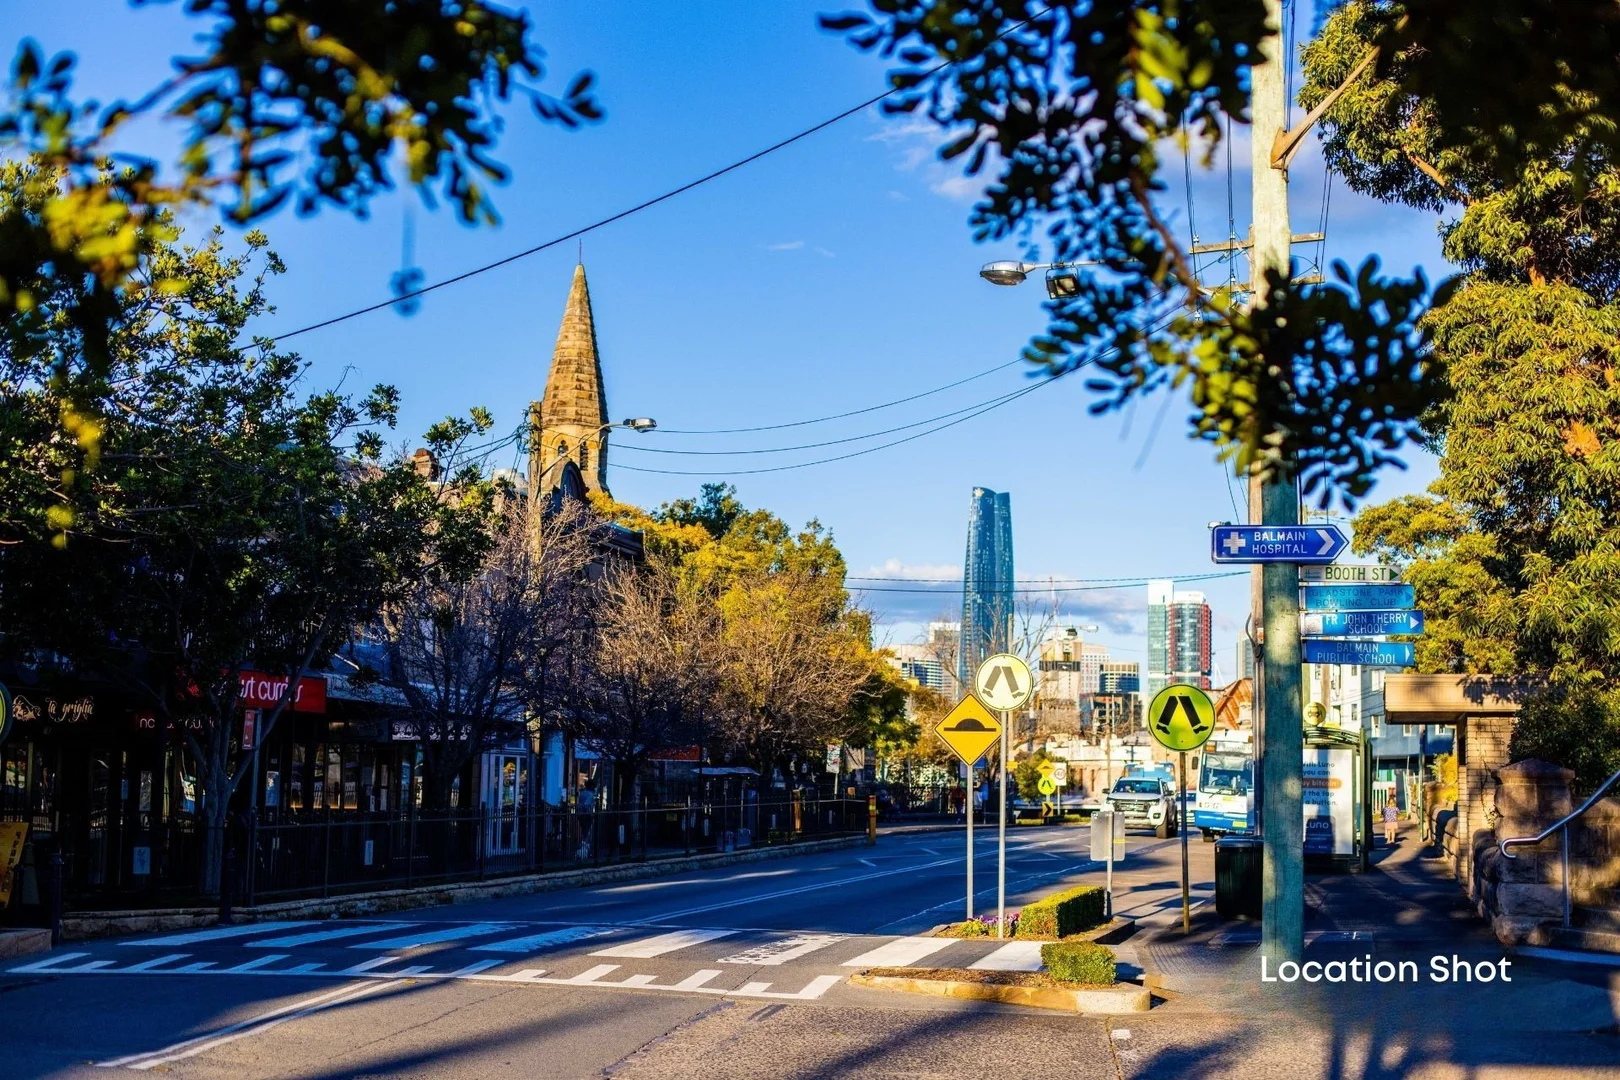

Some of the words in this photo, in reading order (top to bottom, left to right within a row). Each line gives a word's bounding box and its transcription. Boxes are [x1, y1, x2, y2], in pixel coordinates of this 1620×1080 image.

[1254, 531, 1306, 541] BALMAIN
[1252, 544, 1307, 554] HOSPITAL
[1325, 567, 1366, 580] BOOTH
[1372, 567, 1386, 580] ST
[1312, 588, 1372, 597] GLADSTONE
[1379, 587, 1404, 596] PARK
[1315, 598, 1362, 607] BOWLING
[1370, 598, 1396, 606] CLUB
[1325, 614, 1338, 625] FR
[1343, 613, 1367, 625] JOHN
[1372, 612, 1408, 624] THERRY
[1348, 624, 1386, 634] SCHOOL
[1336, 642, 1379, 653] BALMAIN
[1317, 652, 1352, 663] PUBLIC
[1357, 653, 1397, 664] SCHOOL
